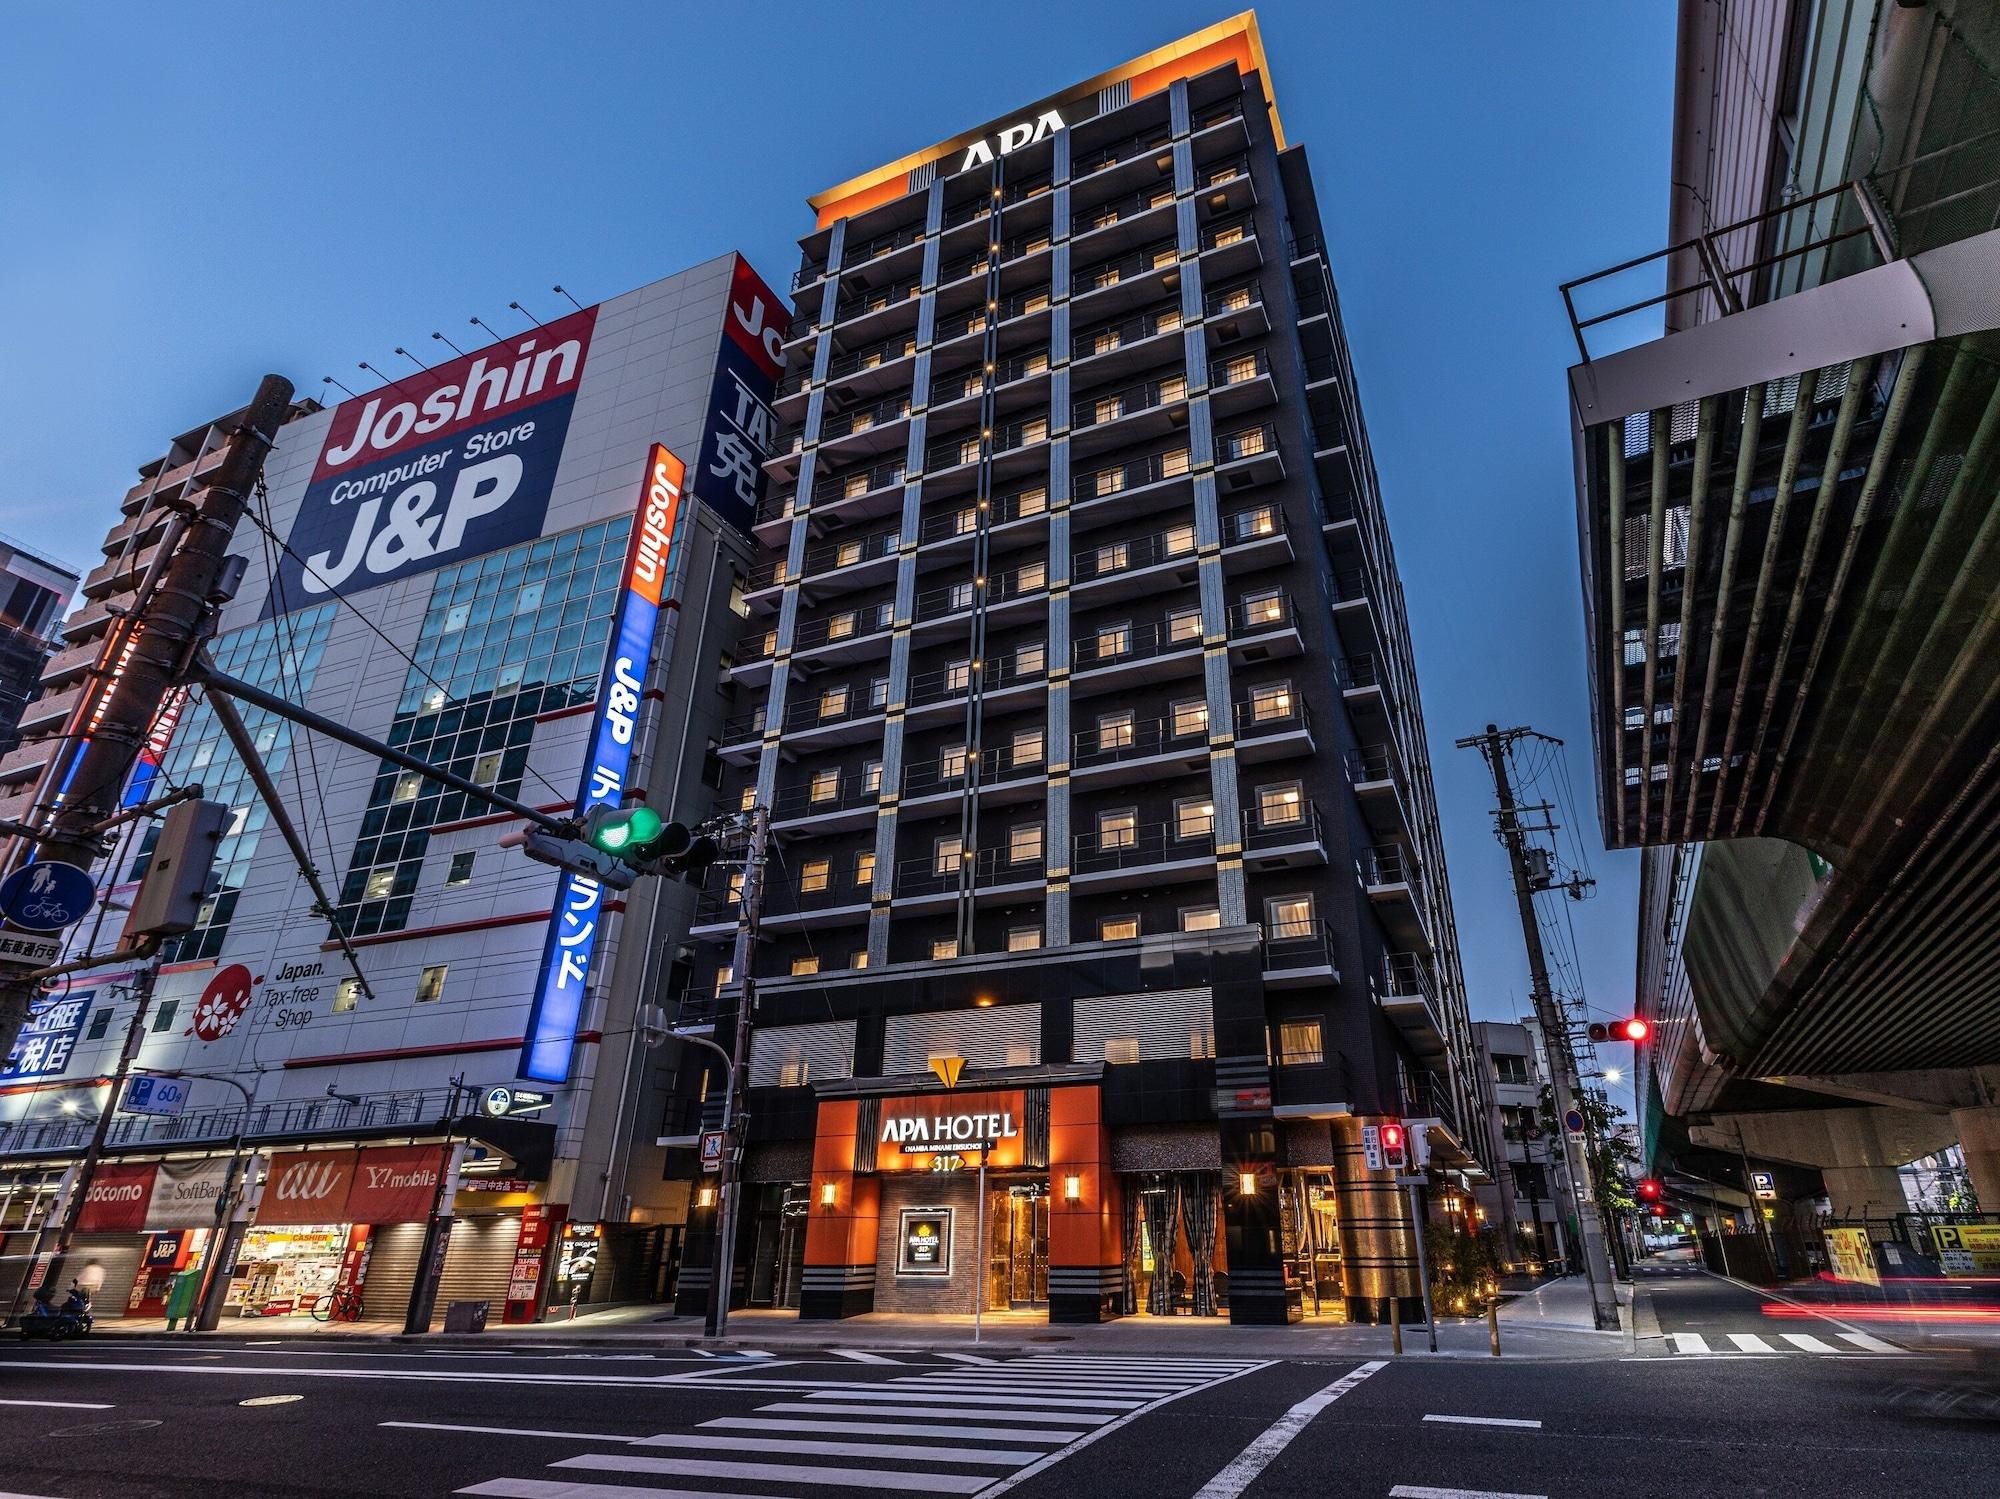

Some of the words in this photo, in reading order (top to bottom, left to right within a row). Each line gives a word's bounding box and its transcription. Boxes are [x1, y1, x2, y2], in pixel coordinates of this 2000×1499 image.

[961, 109, 1066, 173] APA
[325, 338, 582, 467] Joshin
[330, 447, 453, 505] Computer
[463, 420, 536, 460] Store
[301, 453, 524, 594] J&P
[635, 462, 680, 584] Joshin
[606, 656, 641, 746] J&P
[0, 939, 59, 961] 転車通行可
[275, 962, 325, 983] Japan.
[264, 985, 320, 1007] Tax-free
[275, 1008, 313, 1030] Shop
[136, 1080, 151, 1095] P
[881, 1117, 930, 1142] APA
[934, 1113, 1018, 1140] HOTEL
[933, 1155, 960, 1172] 317
[175, 1181, 224, 1201] SoftBan
[276, 1160, 343, 1200] au
[1754, 1175, 1769, 1190] P
[292, 1234, 328, 1242] CASHIER
[1938, 1228, 1957, 1248] P
[153, 1243, 177, 1258] J&P
